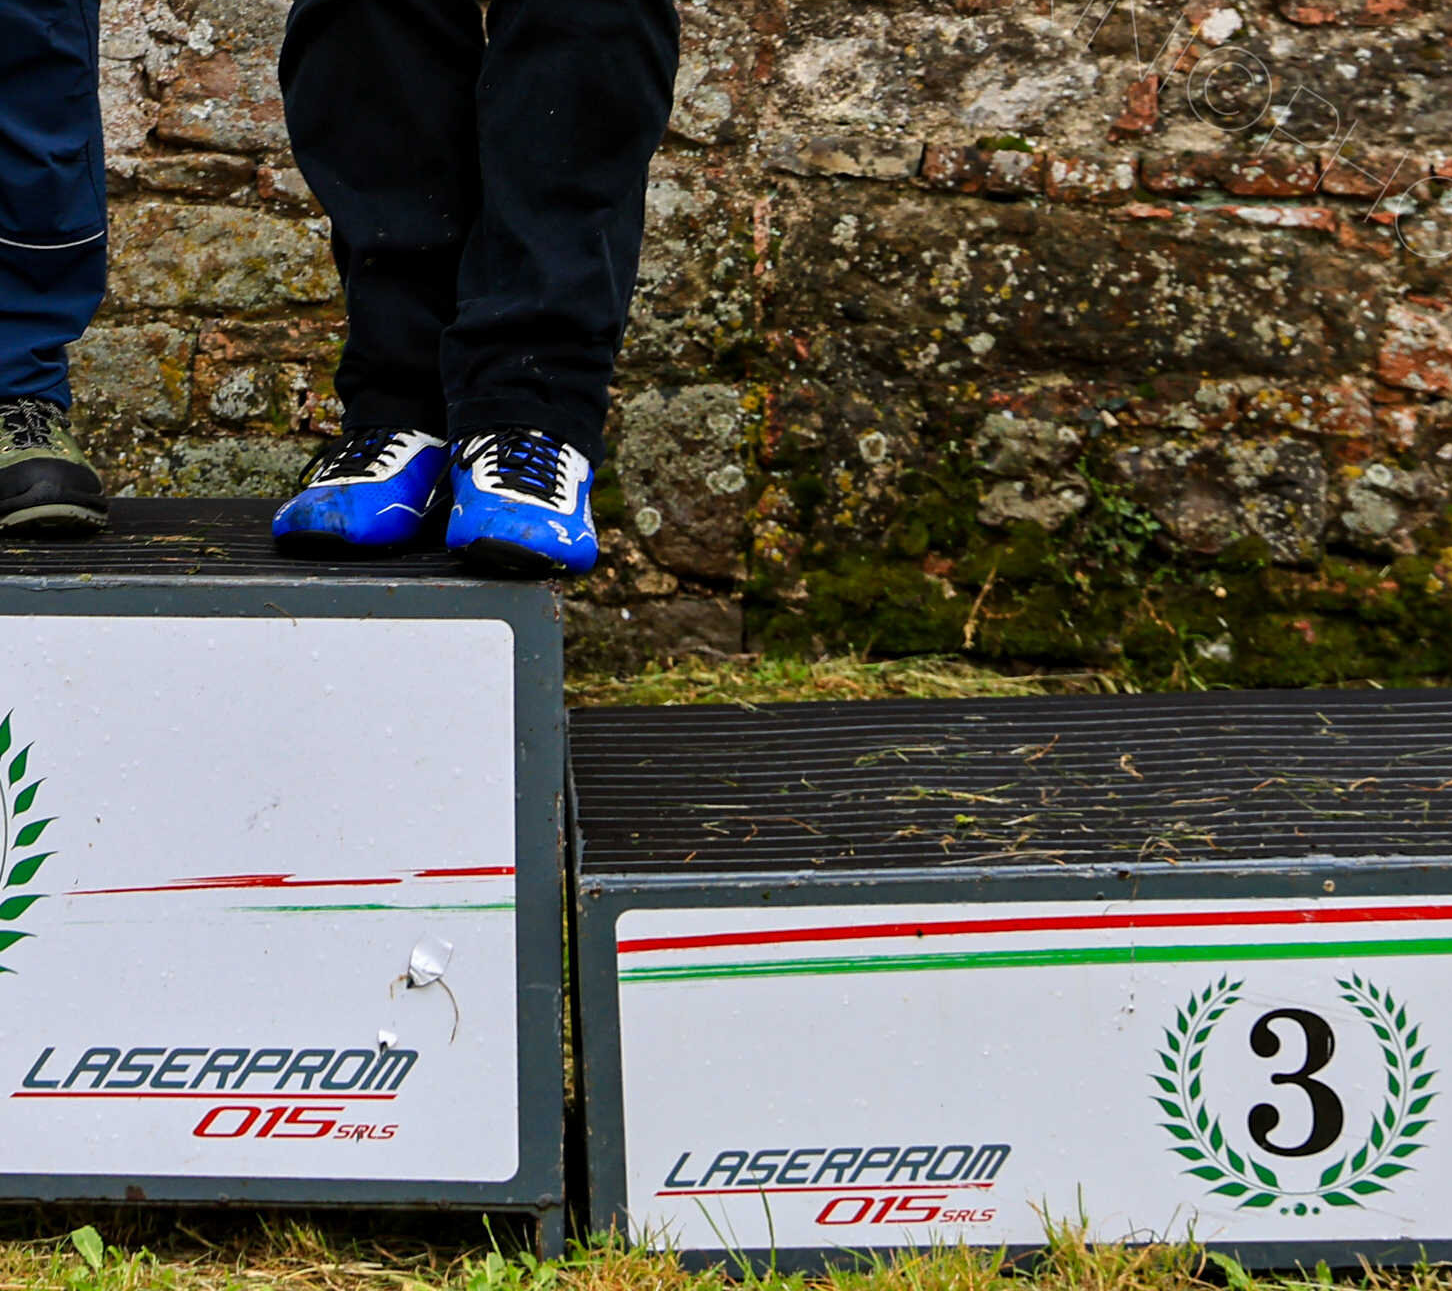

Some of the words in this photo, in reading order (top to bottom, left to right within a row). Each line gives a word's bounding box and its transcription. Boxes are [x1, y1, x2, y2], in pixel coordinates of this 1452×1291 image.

[21, 1046, 420, 1092] LASERPROM
[1247, 1008, 1345, 1158] 3
[333, 1122, 399, 1142] SRLS
[663, 1144, 1013, 1189] LASERPROM
[938, 1206, 998, 1226] SRLS
